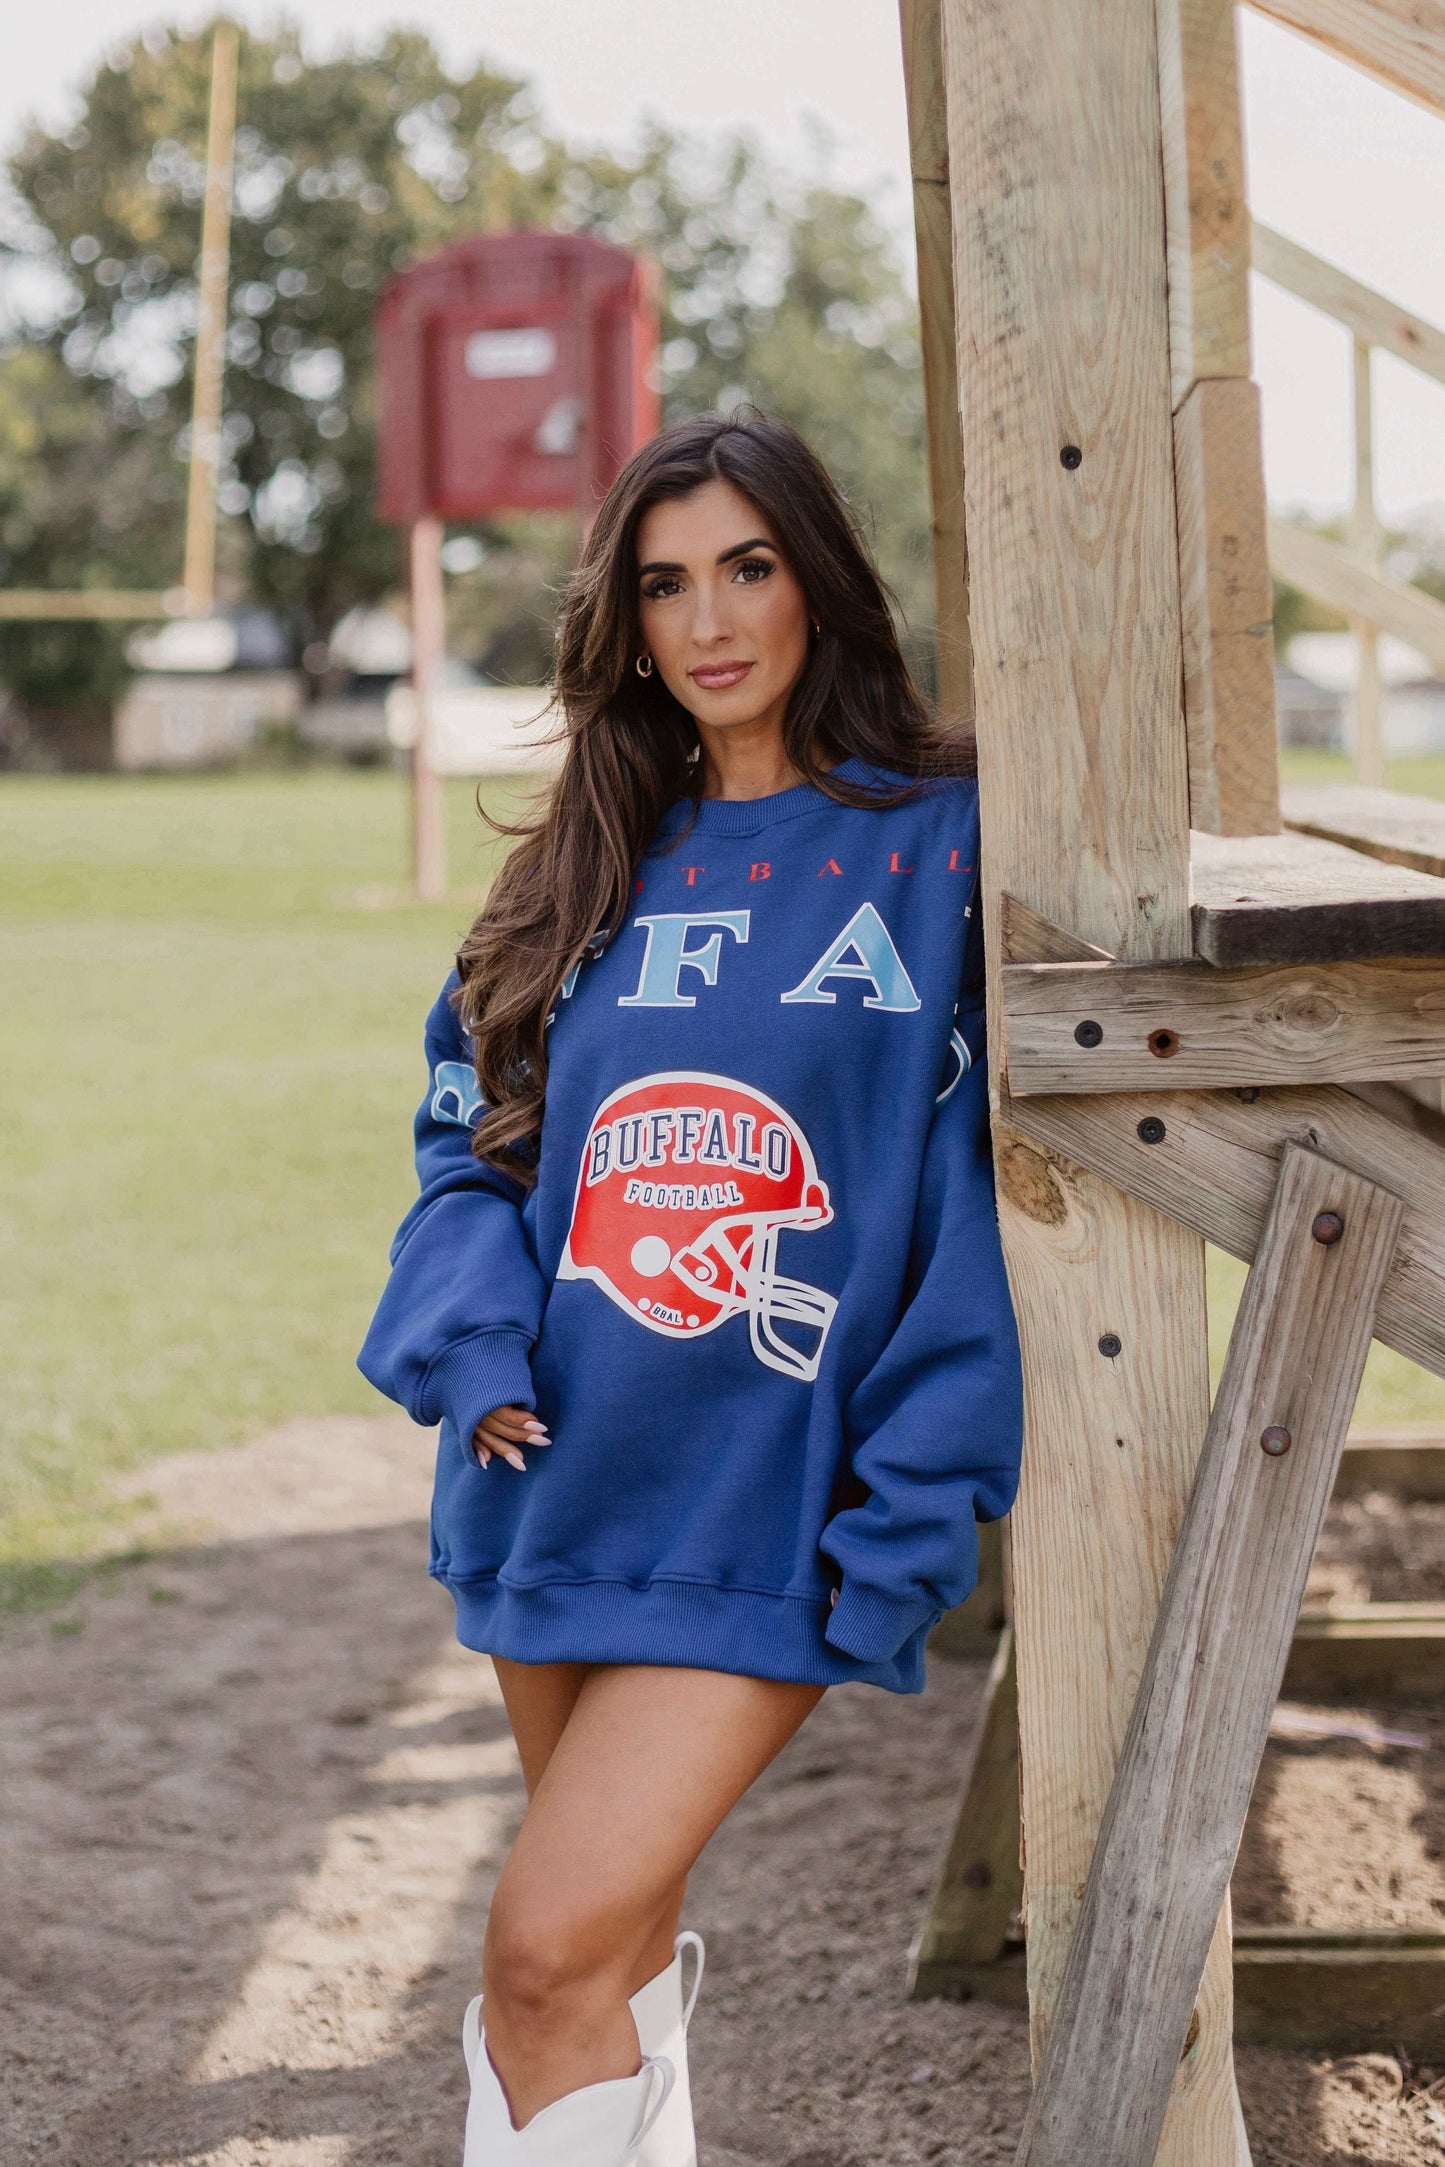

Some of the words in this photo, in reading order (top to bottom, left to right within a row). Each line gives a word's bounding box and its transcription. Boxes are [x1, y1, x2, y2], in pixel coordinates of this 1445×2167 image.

[632, 850, 972, 896] TBALL
[587, 1108, 790, 1186] BUFFALO
[627, 1181, 741, 1208] FOOTBALL
